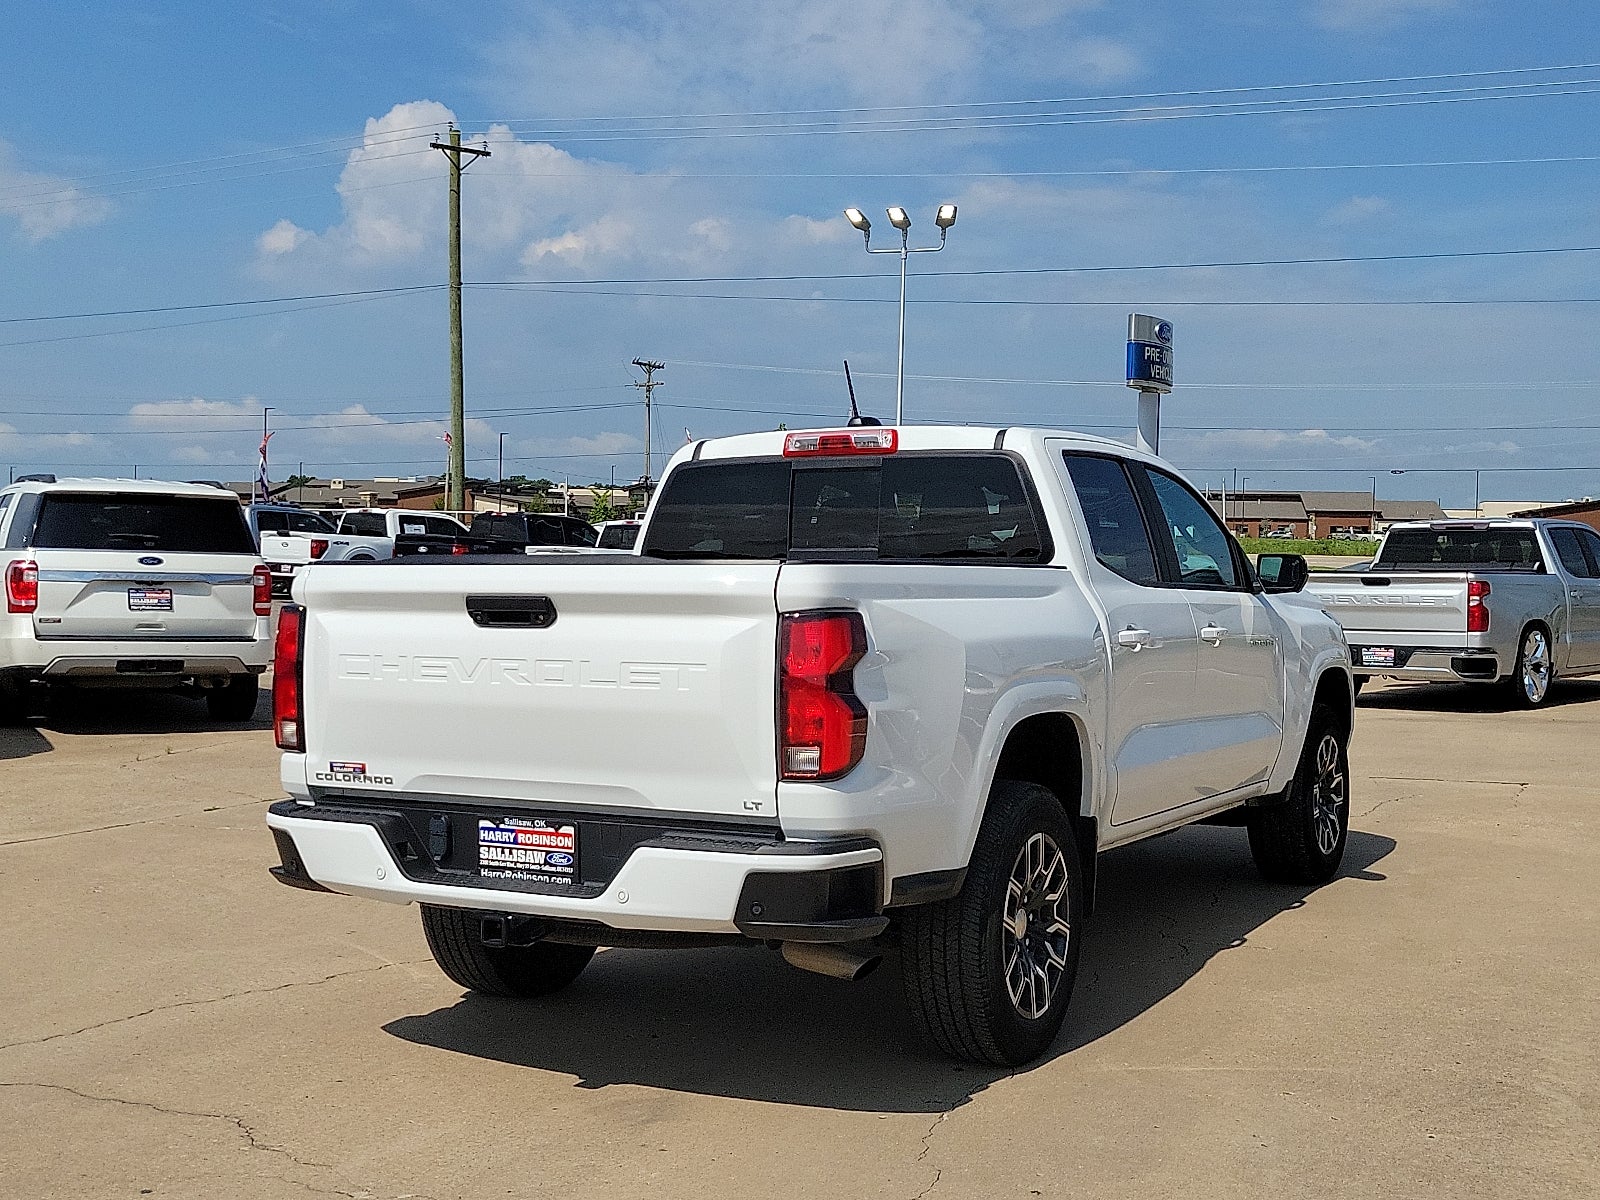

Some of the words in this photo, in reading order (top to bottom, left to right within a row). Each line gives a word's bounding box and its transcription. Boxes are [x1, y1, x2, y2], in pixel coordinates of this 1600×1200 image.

[1314, 594, 1454, 606] HEVROLET
[338, 653, 708, 691] CHEVROLET
[315, 772, 394, 785] COLORADO
[743, 800, 763, 811] LT
[504, 818, 533, 828] Sallisaw,
[534, 820, 546, 828] OK
[480, 830, 516, 843] HARRY
[518, 833, 572, 848] ROBINSON
[479, 846, 546, 864] SALLISAW
[481, 869, 571, 885] HarryRobinson.com
